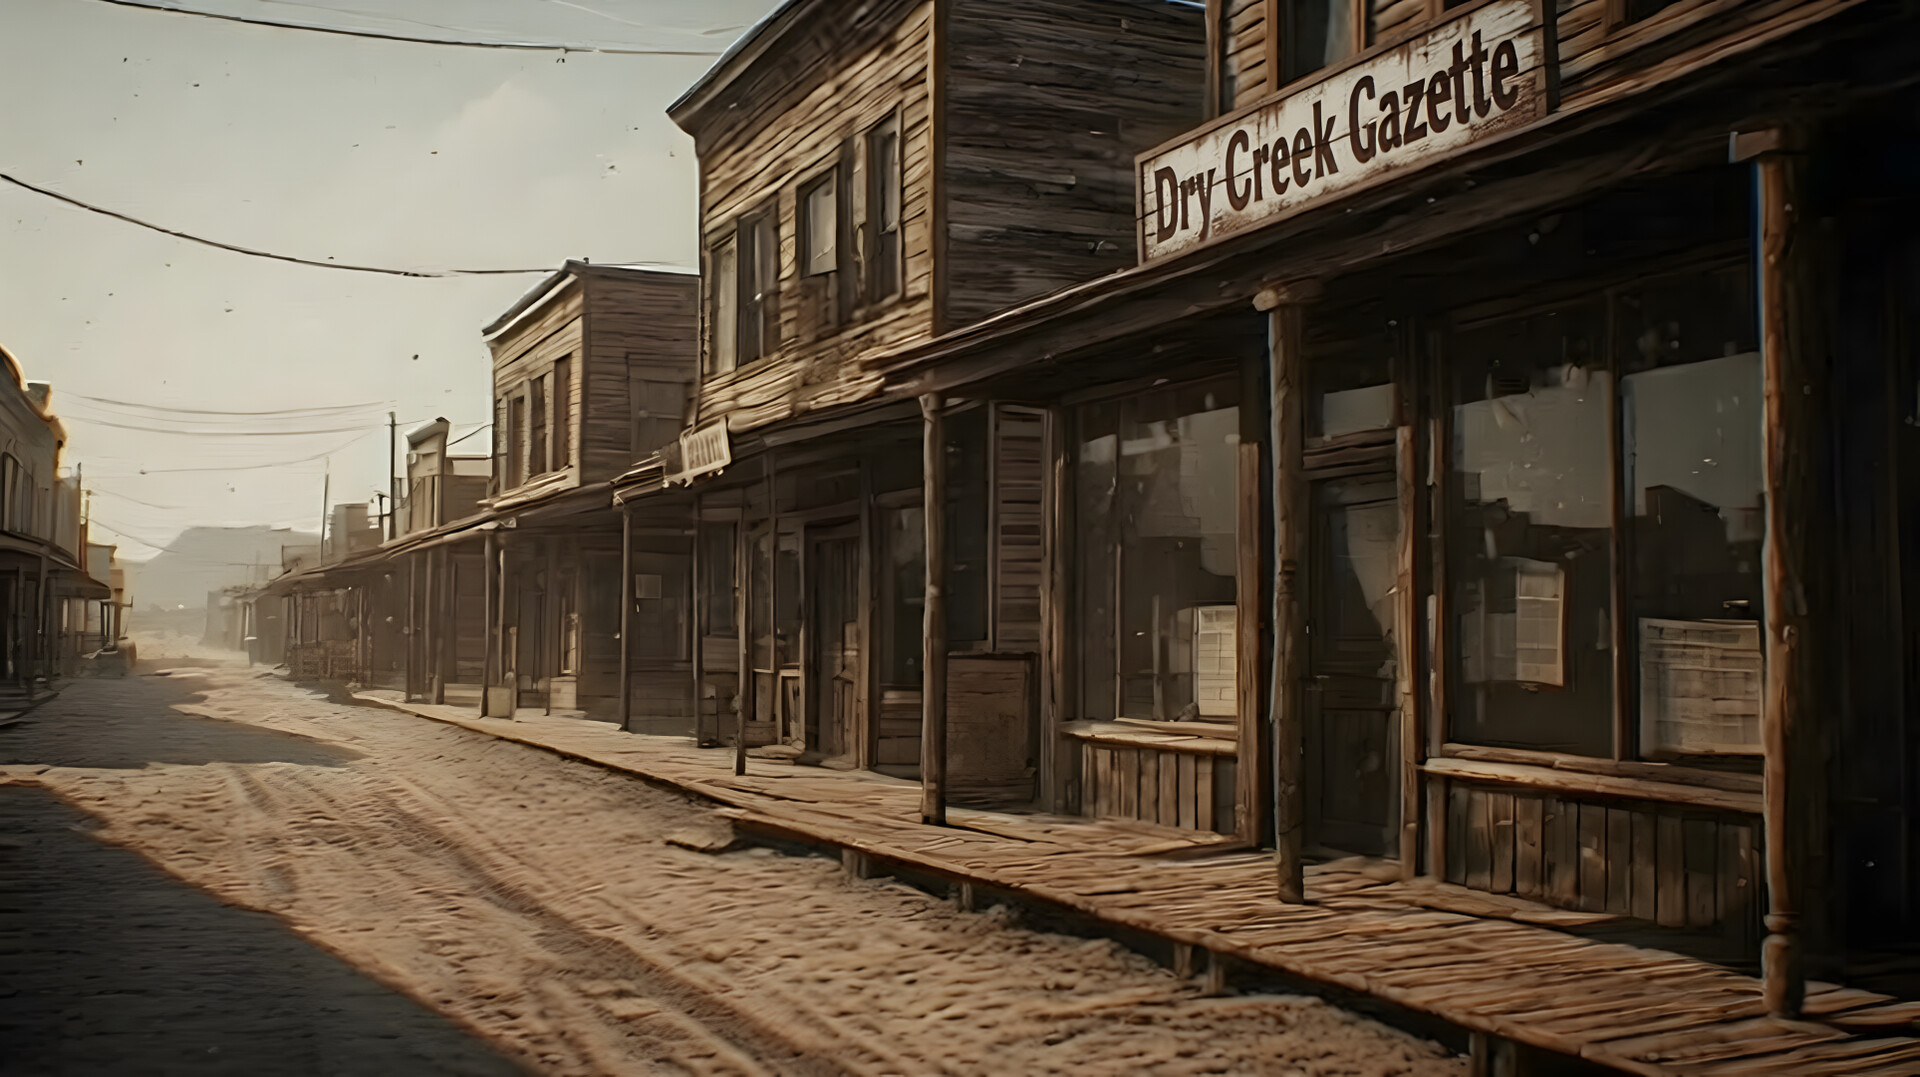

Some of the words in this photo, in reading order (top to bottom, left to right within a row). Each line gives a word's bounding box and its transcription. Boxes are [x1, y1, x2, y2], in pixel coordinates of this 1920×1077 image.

[1154, 166, 1216, 243] Dry
[1225, 101, 1338, 211] Creek
[1349, 29, 1519, 164] Gazette
